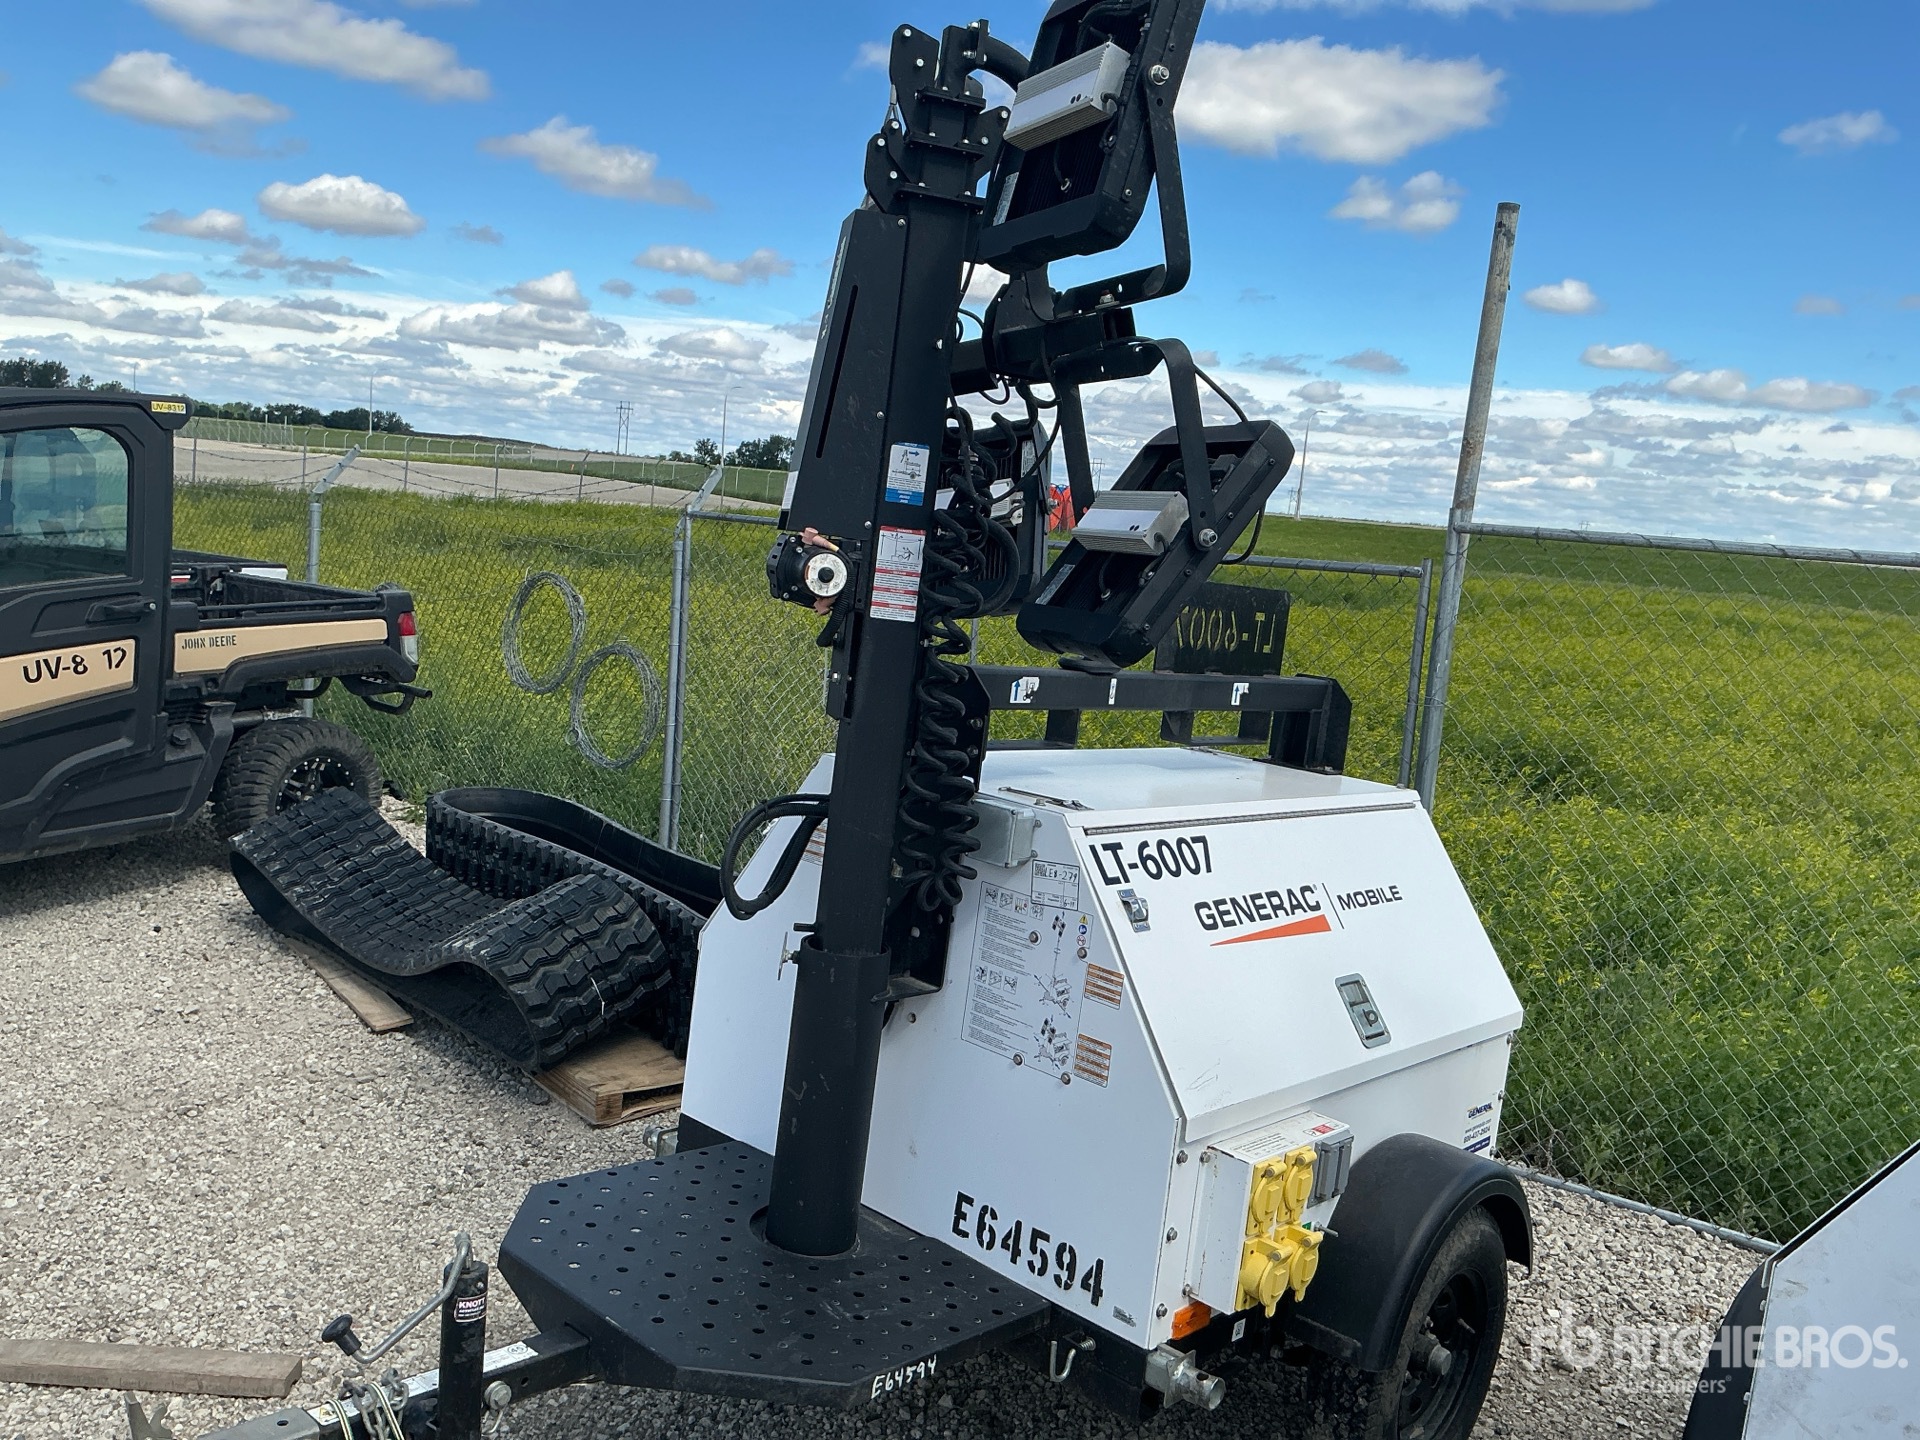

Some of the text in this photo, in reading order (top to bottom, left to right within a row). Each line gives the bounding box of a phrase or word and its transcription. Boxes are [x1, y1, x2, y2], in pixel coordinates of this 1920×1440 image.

[152, 402, 185, 412] UV-8312
[181, 634, 237, 650] JOHN DEERE
[1088, 834, 1213, 886] LT-6007
[1193, 884, 1403, 931] GENERAC MOBILE
[951, 1190, 1105, 1307] E64594
[458, 1297, 486, 1309] KNOTT
[871, 1354, 938, 1400] E64594
